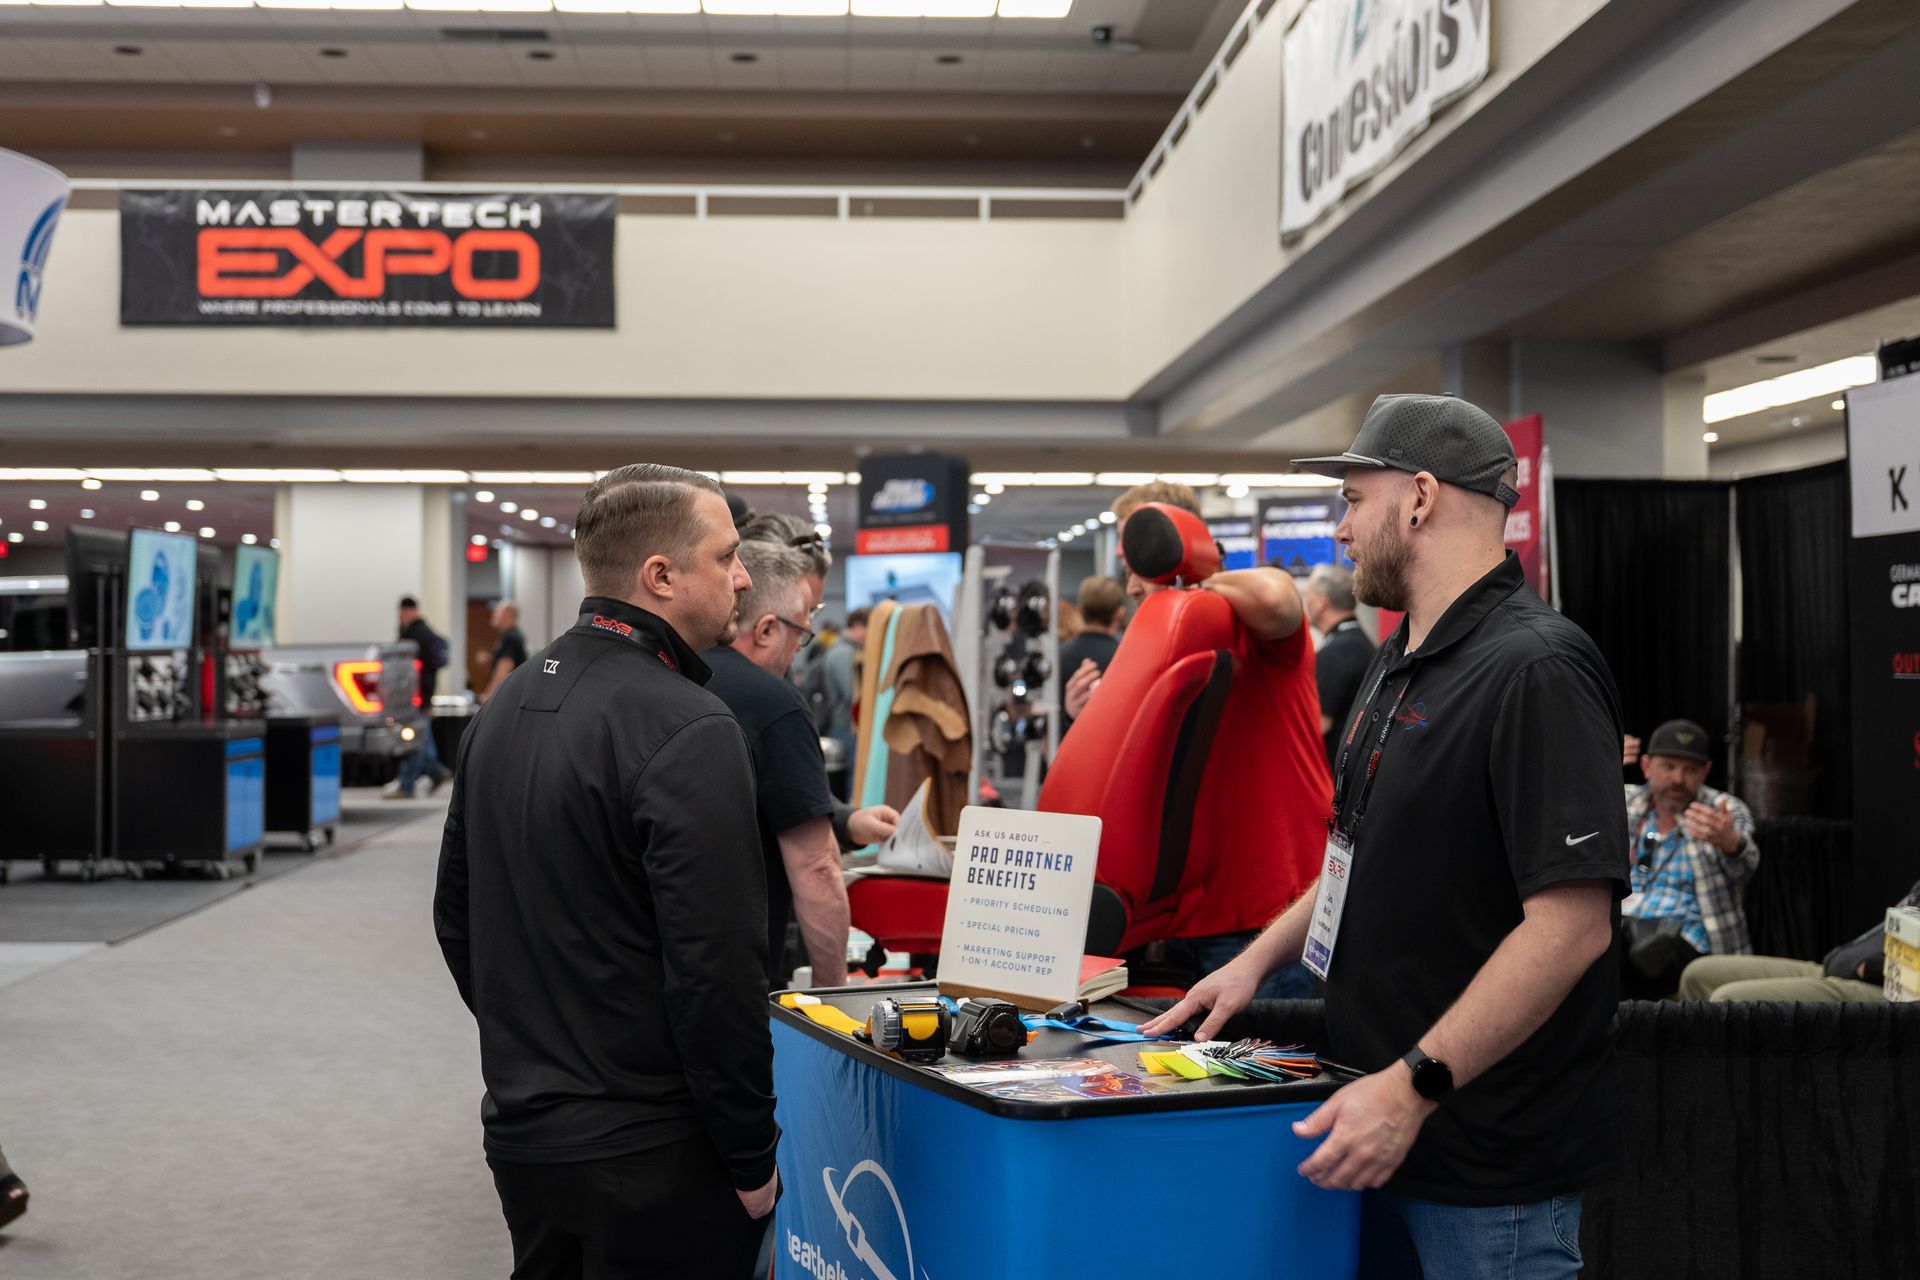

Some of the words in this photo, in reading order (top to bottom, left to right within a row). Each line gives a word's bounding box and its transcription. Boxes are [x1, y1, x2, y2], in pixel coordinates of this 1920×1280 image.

[196, 199, 542, 228] MASTERTECH
[197, 227, 541, 299] EXPO
[199, 301, 258, 315] WHERE
[261, 301, 400, 316] PROFESSIONALS
[402, 301, 451, 316] COME
[455, 301, 481, 316] TO
[482, 302, 542, 317] LEARN
[592, 614, 632, 634] EXPO
[974, 829, 991, 838] ASK
[994, 832, 1006, 840] US
[1009, 834, 1040, 843] ABOUT
[970, 845, 999, 864] PRO
[1004, 848, 1073, 872] PARTNER
[967, 867, 1037, 891] BENEFITS
[970, 897, 1009, 909] PRIORITY
[1012, 902, 1069, 917] SCHEDULING
[966, 920, 1001, 933] SPECIAL
[1004, 925, 1040, 937] PRICING
[963, 944, 1012, 958] MARKETING
[1015, 951, 1056, 964] SUPPORT
[960, 956, 988, 966] 1-ON-1
[990, 960, 1033, 973] ACCOUNT
[1035, 966, 1053, 976] REP
